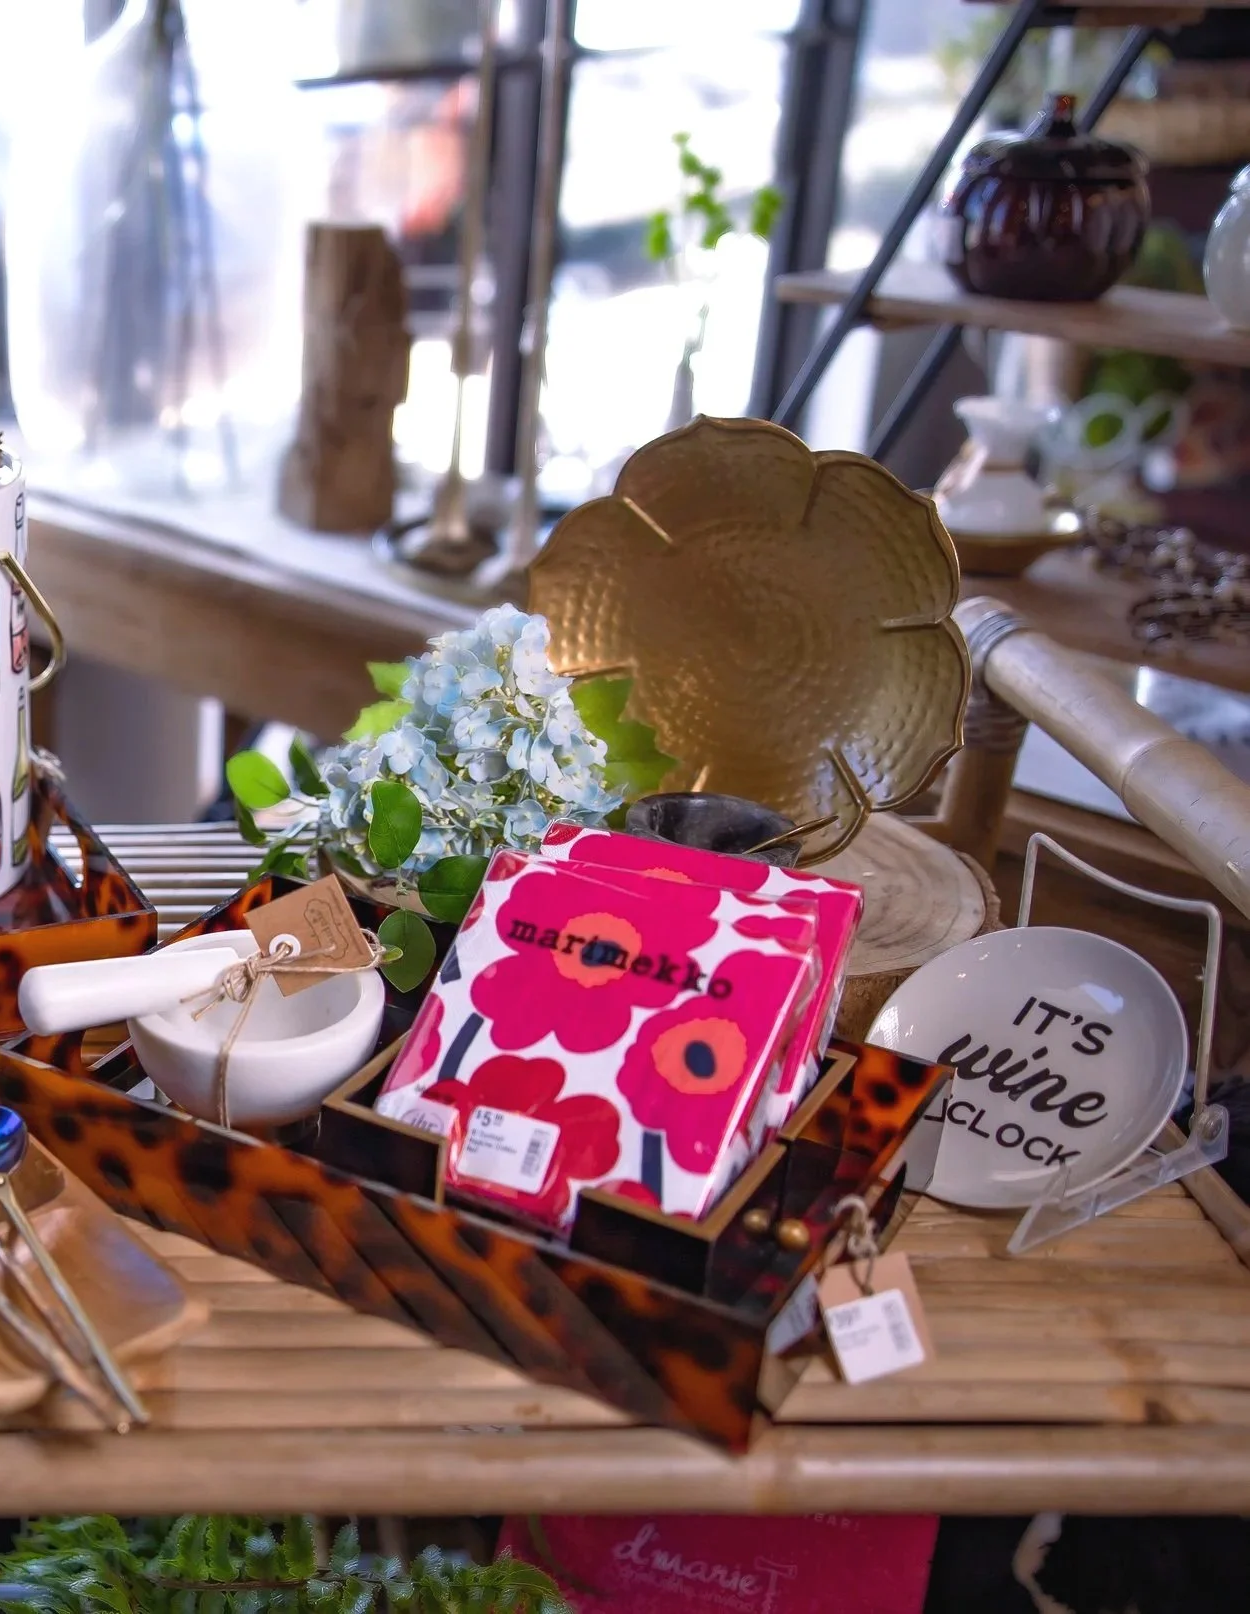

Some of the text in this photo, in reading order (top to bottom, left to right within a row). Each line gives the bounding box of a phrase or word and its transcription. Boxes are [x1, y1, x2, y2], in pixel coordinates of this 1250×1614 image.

[508, 918, 734, 1000] marimekko
[1012, 996, 1113, 1056] IT'S
[937, 1033, 1109, 1129] wine
